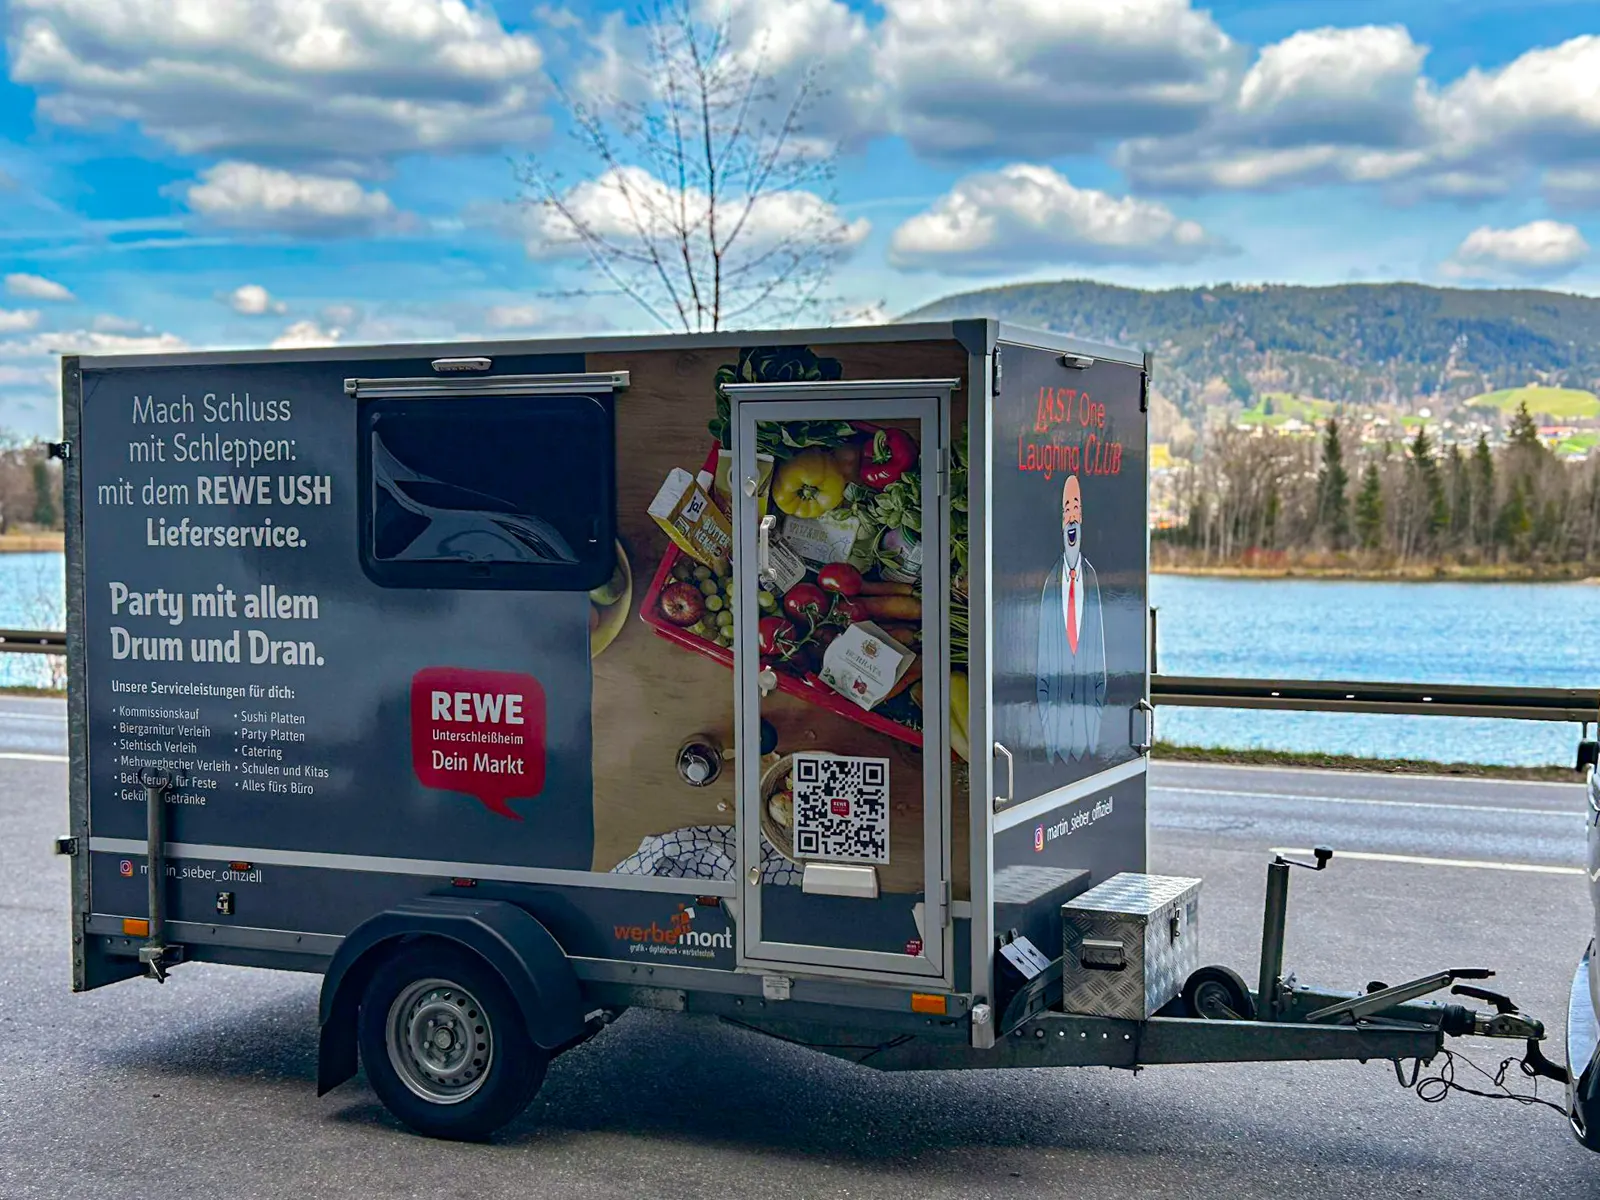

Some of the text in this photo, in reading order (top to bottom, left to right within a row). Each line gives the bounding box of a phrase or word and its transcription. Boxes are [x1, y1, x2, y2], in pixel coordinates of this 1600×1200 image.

[132, 393, 291, 424] Mach Schluss
[1079, 392, 1106, 429] One
[129, 433, 296, 468] mit Schleppen:
[1018, 432, 1123, 480] Laughing CLUB
[98, 475, 332, 505] mit dem REWE USH
[687, 496, 704, 514] ja!
[146, 517, 307, 548] Lieferservice.
[109, 581, 319, 626] Party mit allem
[110, 627, 325, 666] Drum und Dran.
[111, 679, 295, 700] Unsere Serviceleistungen für dich:
[119, 705, 200, 720] Kommissionskauf
[431, 691, 524, 725] REWE
[241, 711, 305, 725] Sushi Platten
[119, 722, 211, 738] Biergarnitur Verleih
[241, 728, 305, 743] Party Platten
[432, 729, 524, 745] Unterschleißheim
[119, 739, 197, 754] Stehtisch Verleih
[241, 745, 282, 761] Catering
[120, 755, 231, 773] Mehrwegbecher Verleih
[241, 762, 329, 778] Schulen und Kitas
[432, 749, 524, 775] Dein Markt
[120, 772, 217, 790] Beliferun für Feste
[242, 780, 314, 795] Alles fürs Büro
[120, 788, 206, 806] Gekü Getränke
[1047, 796, 1113, 841] martin_sieber_offiziell
[140, 864, 262, 883] min_sieber_offiziell
